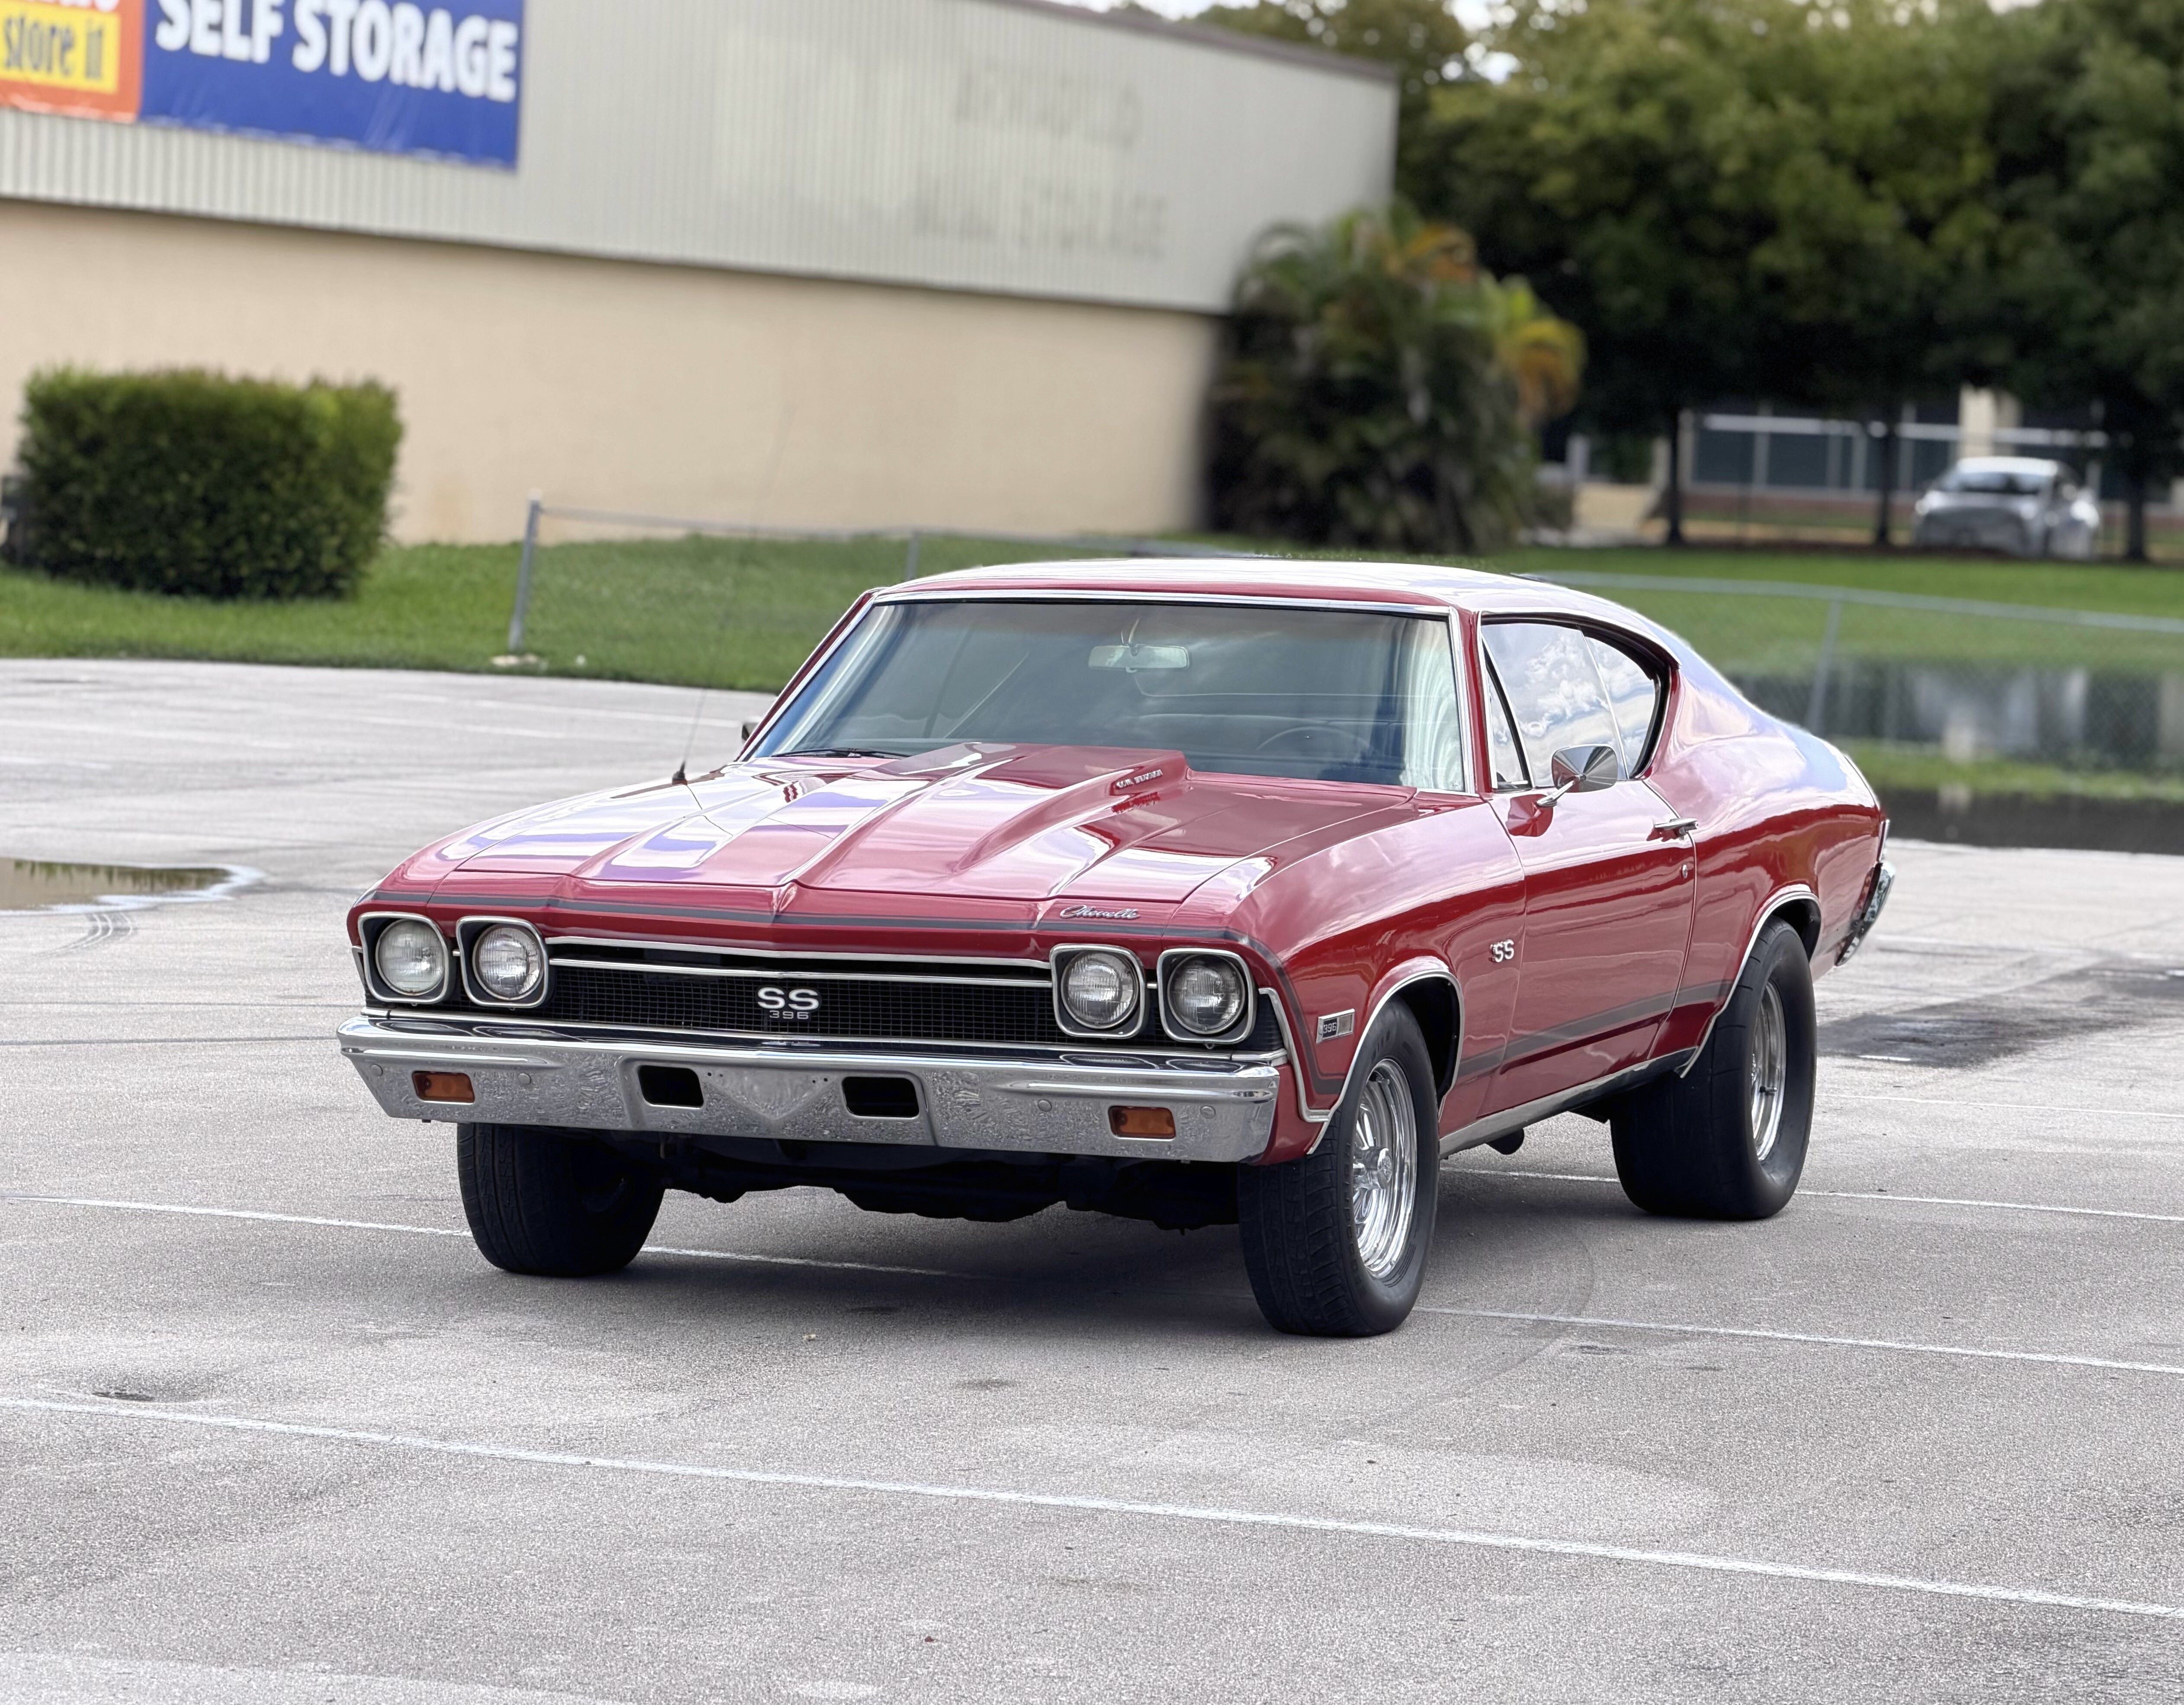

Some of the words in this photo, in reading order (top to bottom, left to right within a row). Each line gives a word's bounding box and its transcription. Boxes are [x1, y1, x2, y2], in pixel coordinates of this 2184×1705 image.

[155, 0, 284, 64] SELF
[292, 0, 519, 103] STORAGE
[1060, 904, 1141, 919] Chevelle
[1490, 939, 1514, 962] SS
[757, 987, 819, 1010] SS
[769, 1010, 809, 1019] 396
[1323, 1022, 1337, 1034] 396
